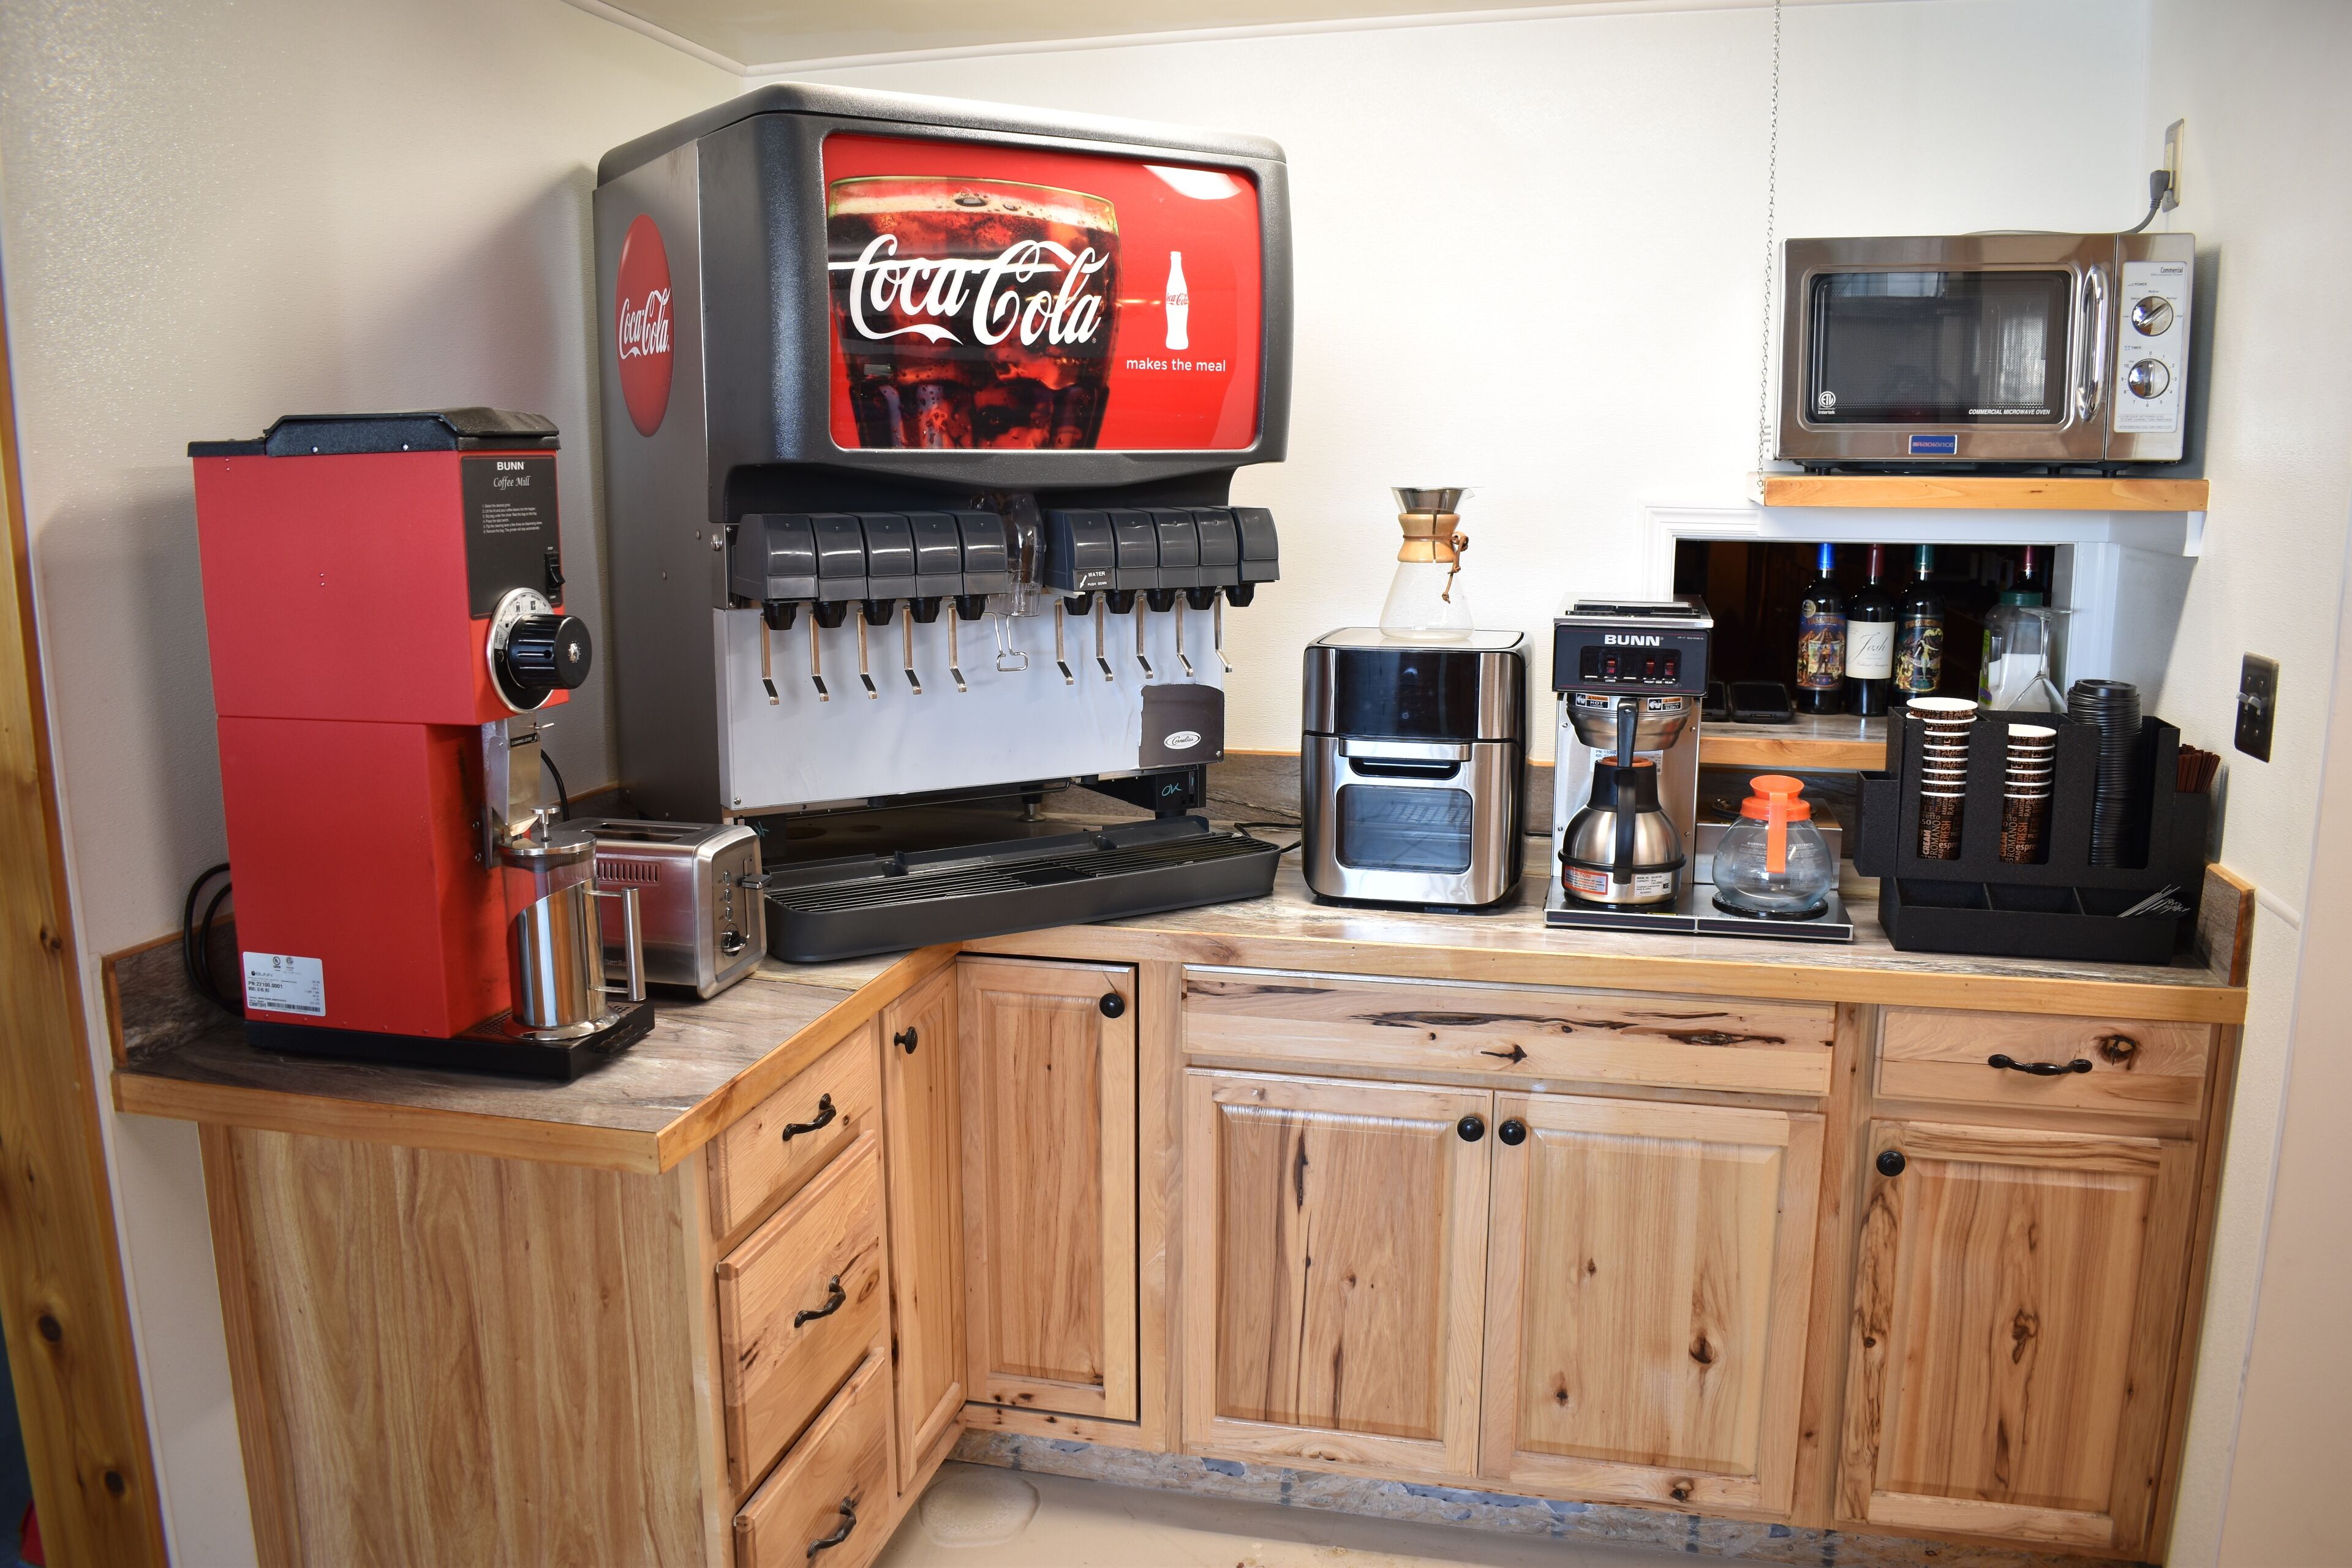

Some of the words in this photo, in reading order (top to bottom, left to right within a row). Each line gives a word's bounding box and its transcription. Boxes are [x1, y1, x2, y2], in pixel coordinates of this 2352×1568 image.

[850, 234, 1110, 346] Coca-Cola
[619, 287, 671, 360] Coca-Cola
[1126, 358, 1167, 371] makes
[1172, 358, 1192, 371] the
[1196, 360, 1226, 372] meal
[497, 461, 524, 470] BUNN
[494, 476, 514, 490] Coffee
[515, 475, 531, 486] Mill
[1605, 635, 1660, 646] BUNN
[1847, 632, 1888, 663] Josh
[1172, 736, 1194, 745] Cornelius
[1161, 783, 1182, 796] OK
[1923, 829, 1931, 855] CREAM
[1930, 820, 1941, 856] ROMANO
[1939, 821, 1952, 842] FRESH
[2007, 821, 2018, 858] ROMANO
[2016, 822, 2029, 845] FRESH
